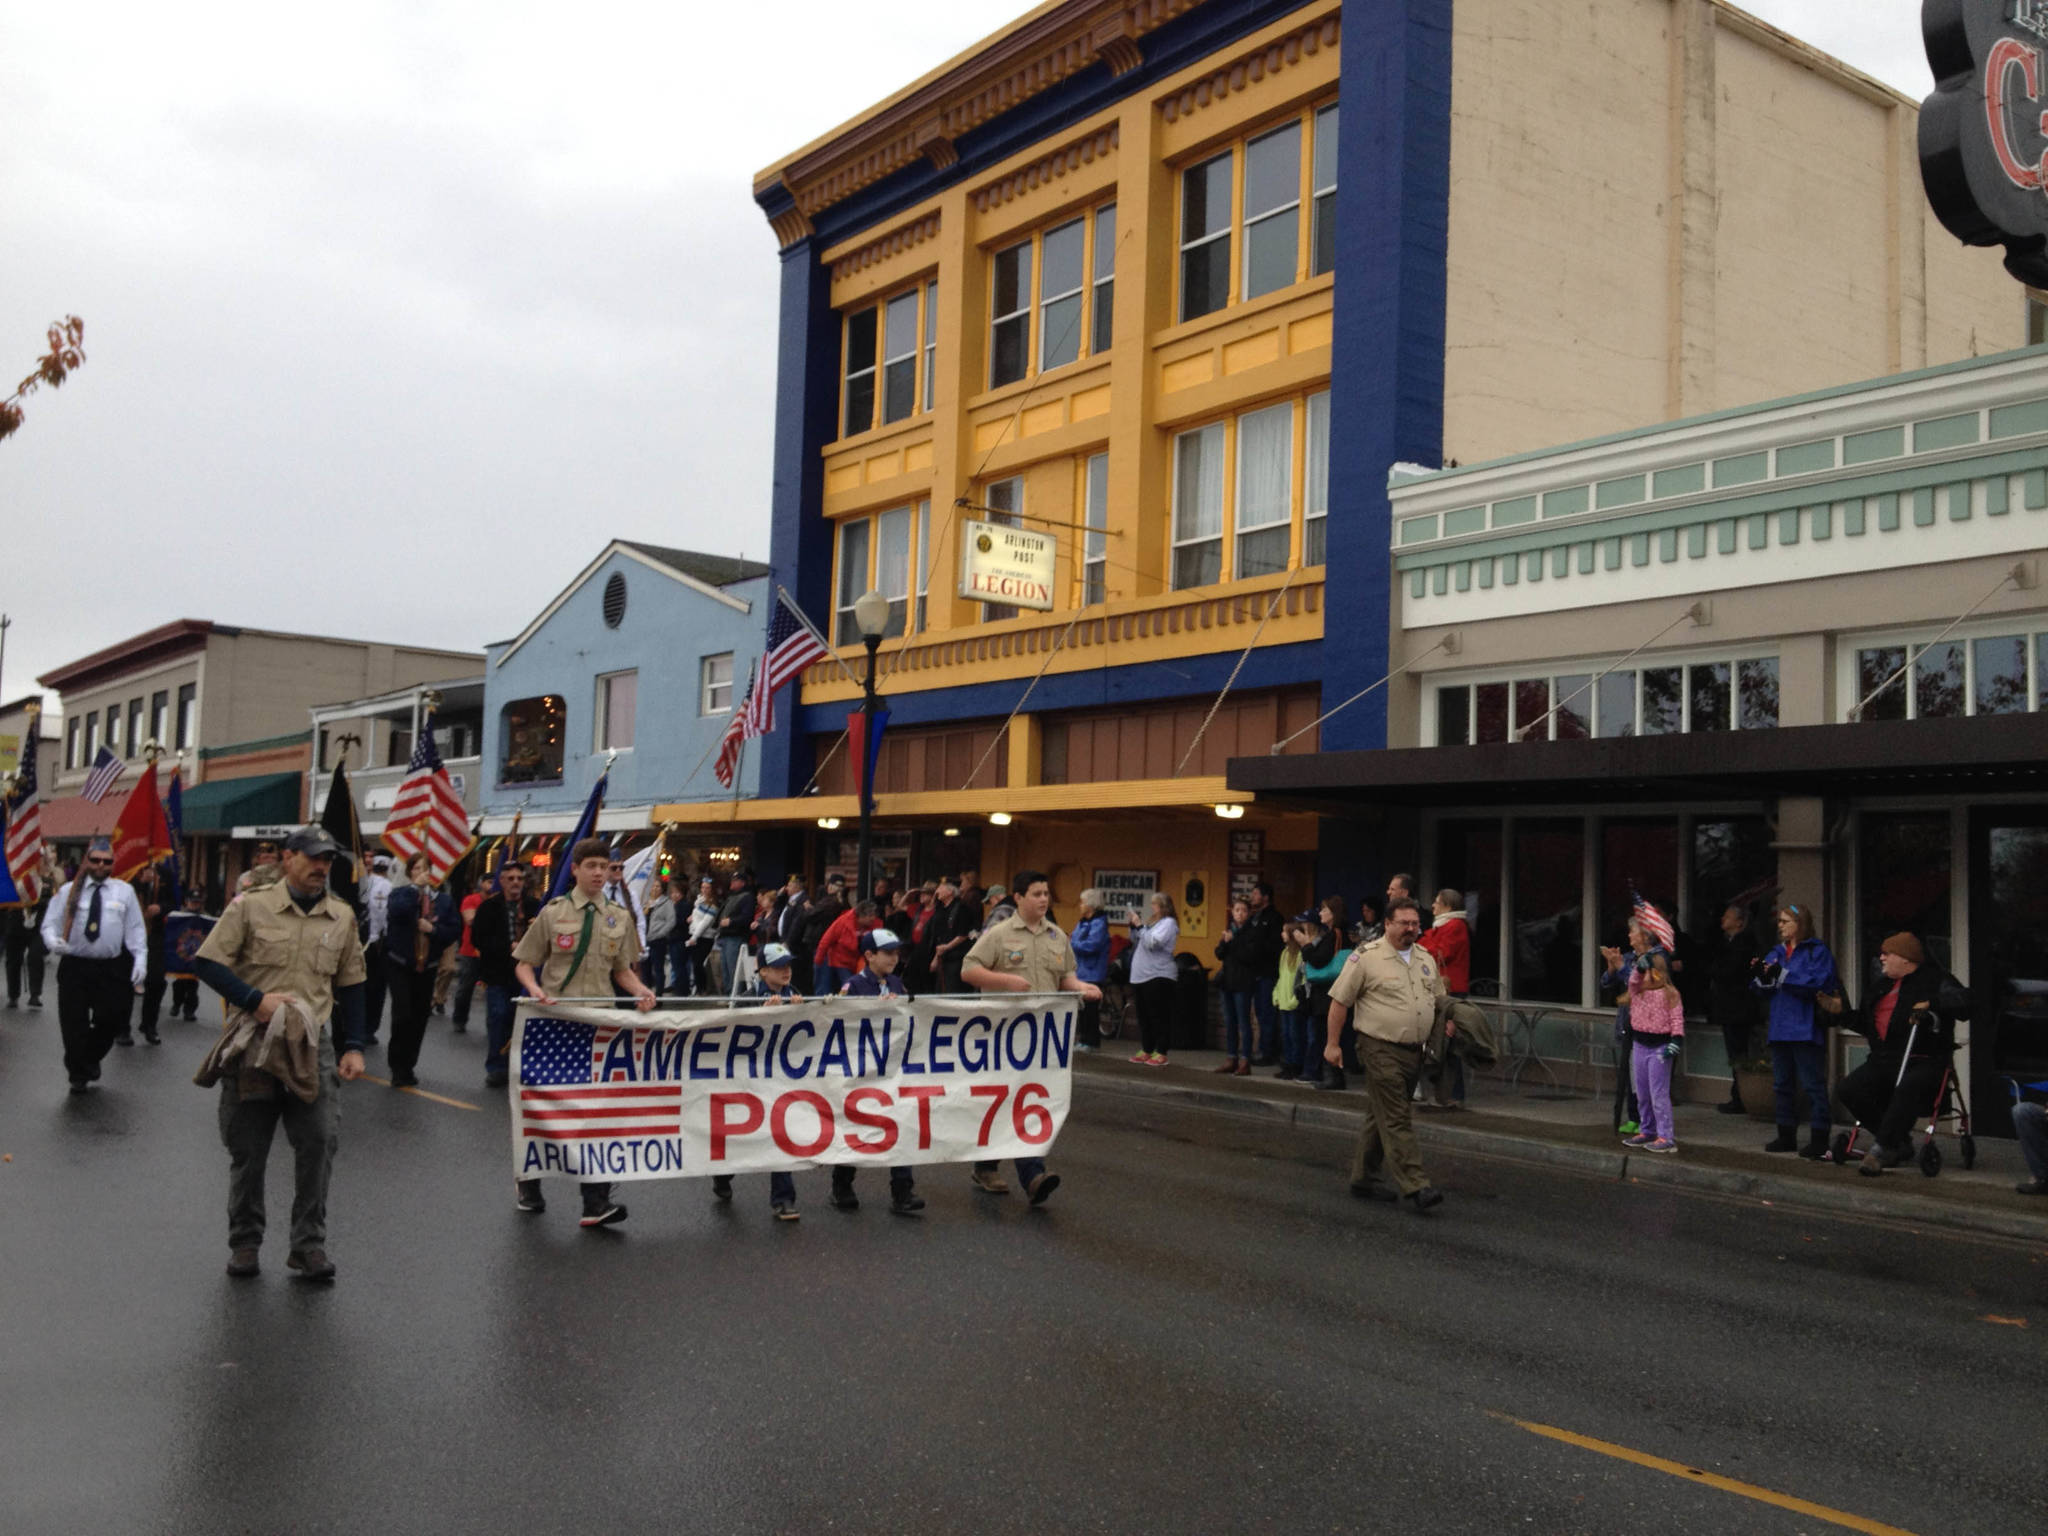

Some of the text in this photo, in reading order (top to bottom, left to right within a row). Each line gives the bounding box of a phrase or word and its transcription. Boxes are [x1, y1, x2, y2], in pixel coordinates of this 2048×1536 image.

[1005, 533, 1044, 551] ARLINGTON
[1014, 550, 1034, 564] POST
[972, 573, 1050, 602] LEGION
[1097, 875, 1153, 890] AMERICAN
[1103, 891, 1143, 907] LEGION
[601, 1011, 1073, 1082] AMERICAN LEGION
[709, 1083, 1053, 1162] POST 76
[524, 1138, 683, 1176] ARLINGTON
